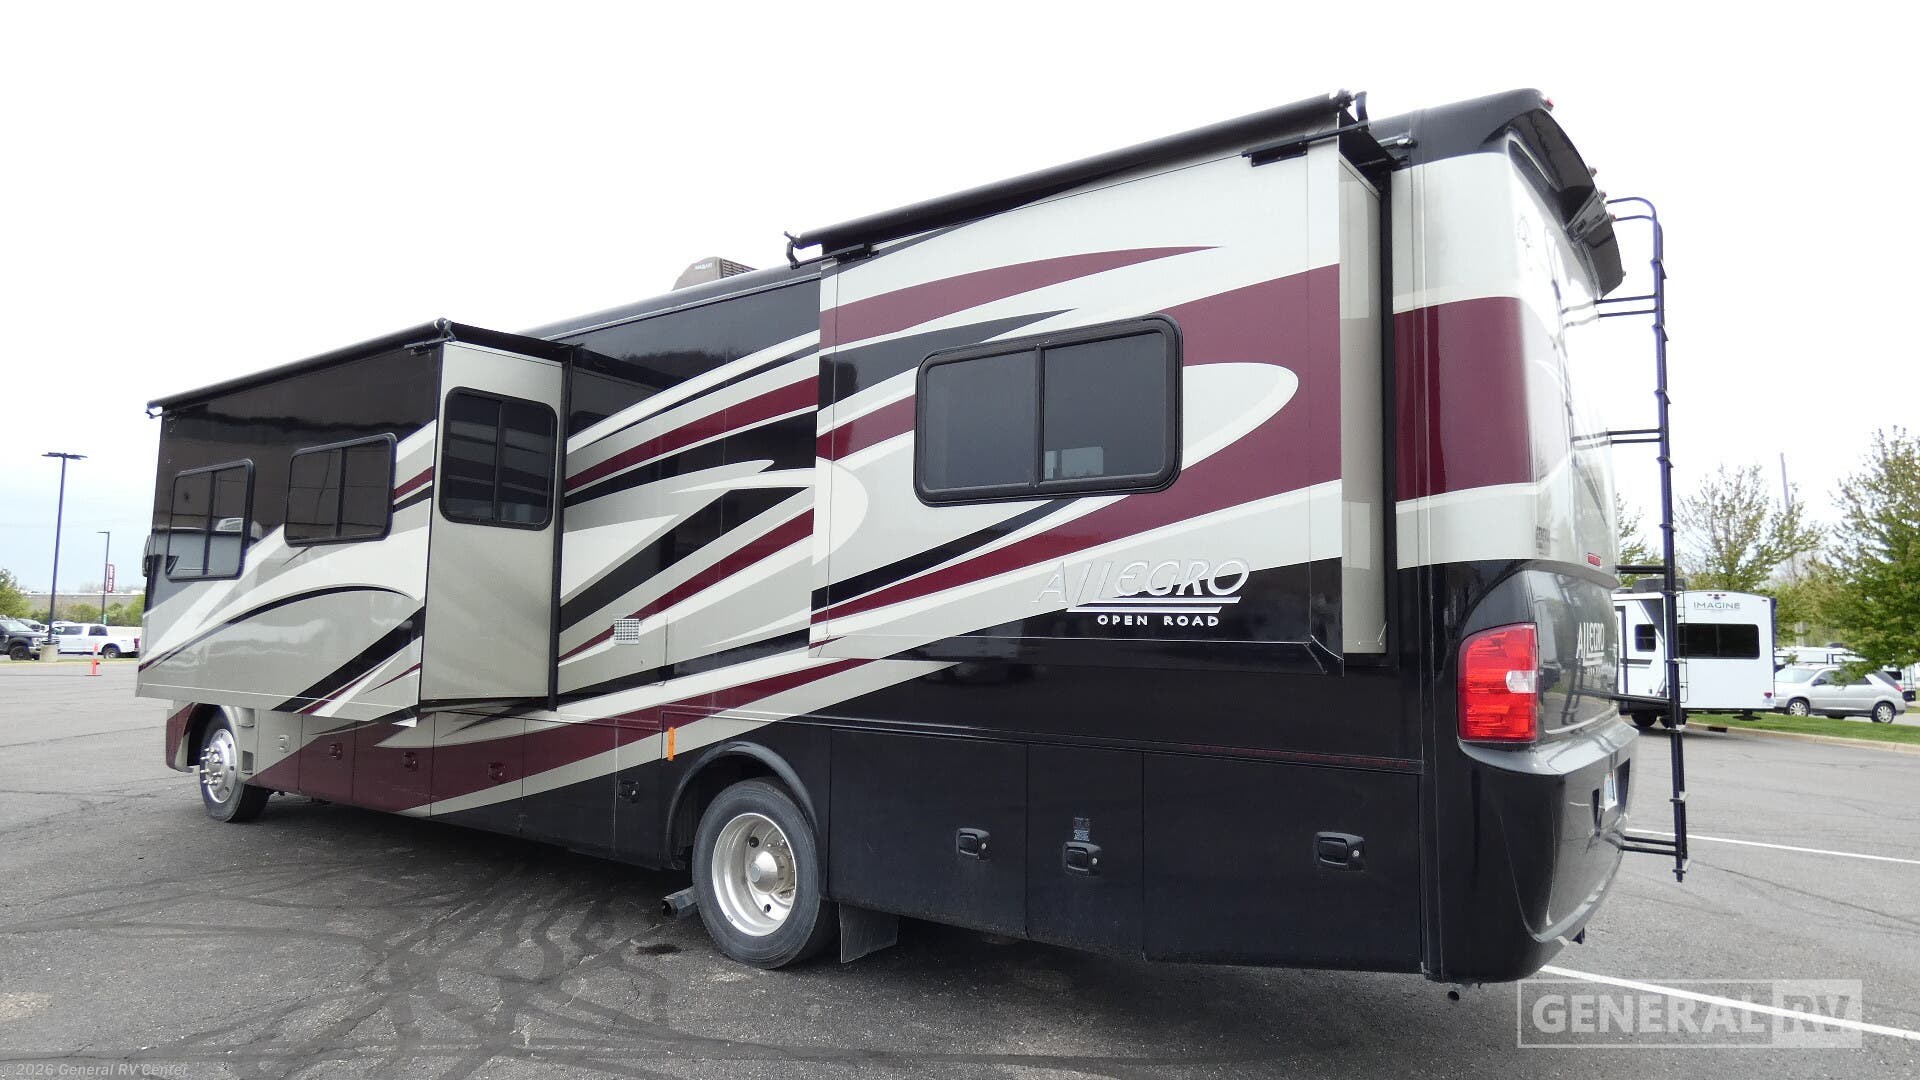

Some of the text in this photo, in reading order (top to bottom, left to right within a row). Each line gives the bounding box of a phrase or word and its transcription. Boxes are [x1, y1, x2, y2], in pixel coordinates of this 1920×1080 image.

[1032, 559, 1250, 606] ALLEGRO
[1694, 601, 1741, 609] IMAGINE
[1098, 615, 1219, 627] OPEN ROAD
